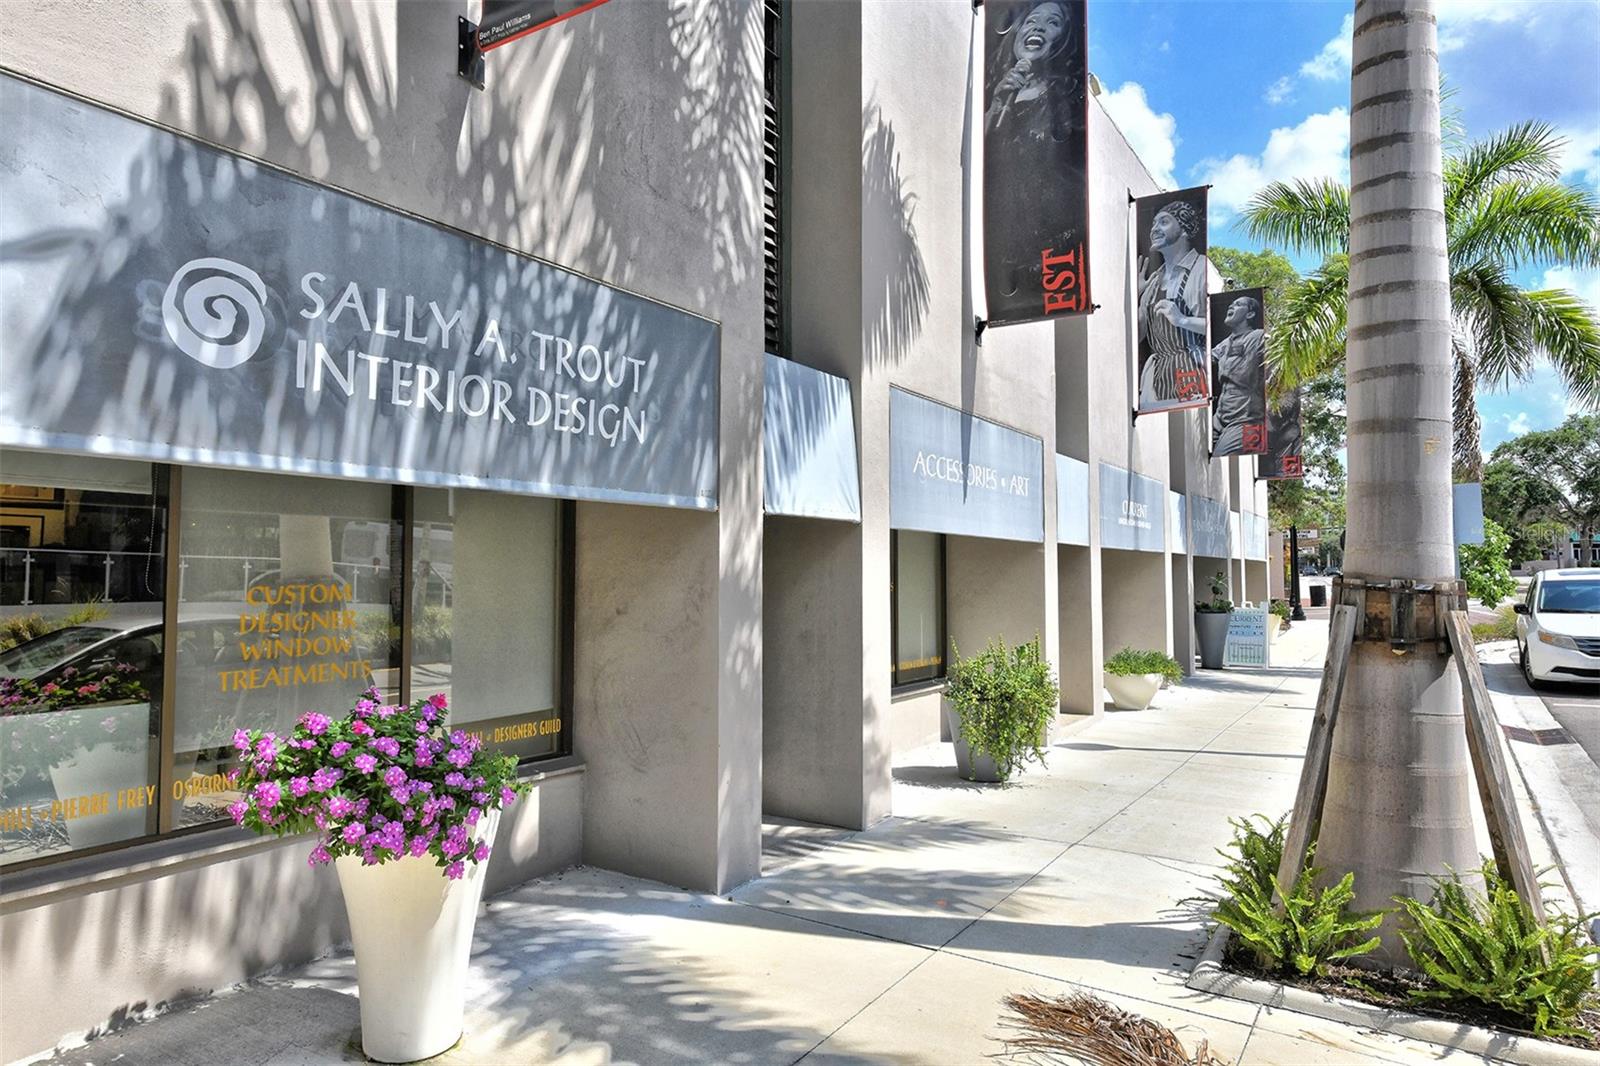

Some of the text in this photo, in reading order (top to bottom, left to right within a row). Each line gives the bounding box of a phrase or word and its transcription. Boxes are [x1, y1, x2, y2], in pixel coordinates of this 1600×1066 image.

[491, 22, 505, 34] Paul
[1041, 247, 1077, 316] FST
[299, 271, 646, 393] SALLY A. TROUT
[296, 339, 646, 447] INTERIOR DESIGN
[1175, 368, 1199, 401] ST
[913, 451, 1030, 497] ACCESSORIES ART
[247, 583, 353, 606] CUSTOM
[239, 609, 357, 635] DESIGNER
[240, 634, 353, 661] WINDOW
[218, 660, 371, 692] TREATMENTS
[494, 722, 537, 744] DESIGNERS
[539, 718, 562, 736] GUILD
[50, 792, 111, 822] PIERRE
[117, 785, 156, 811] FREY
